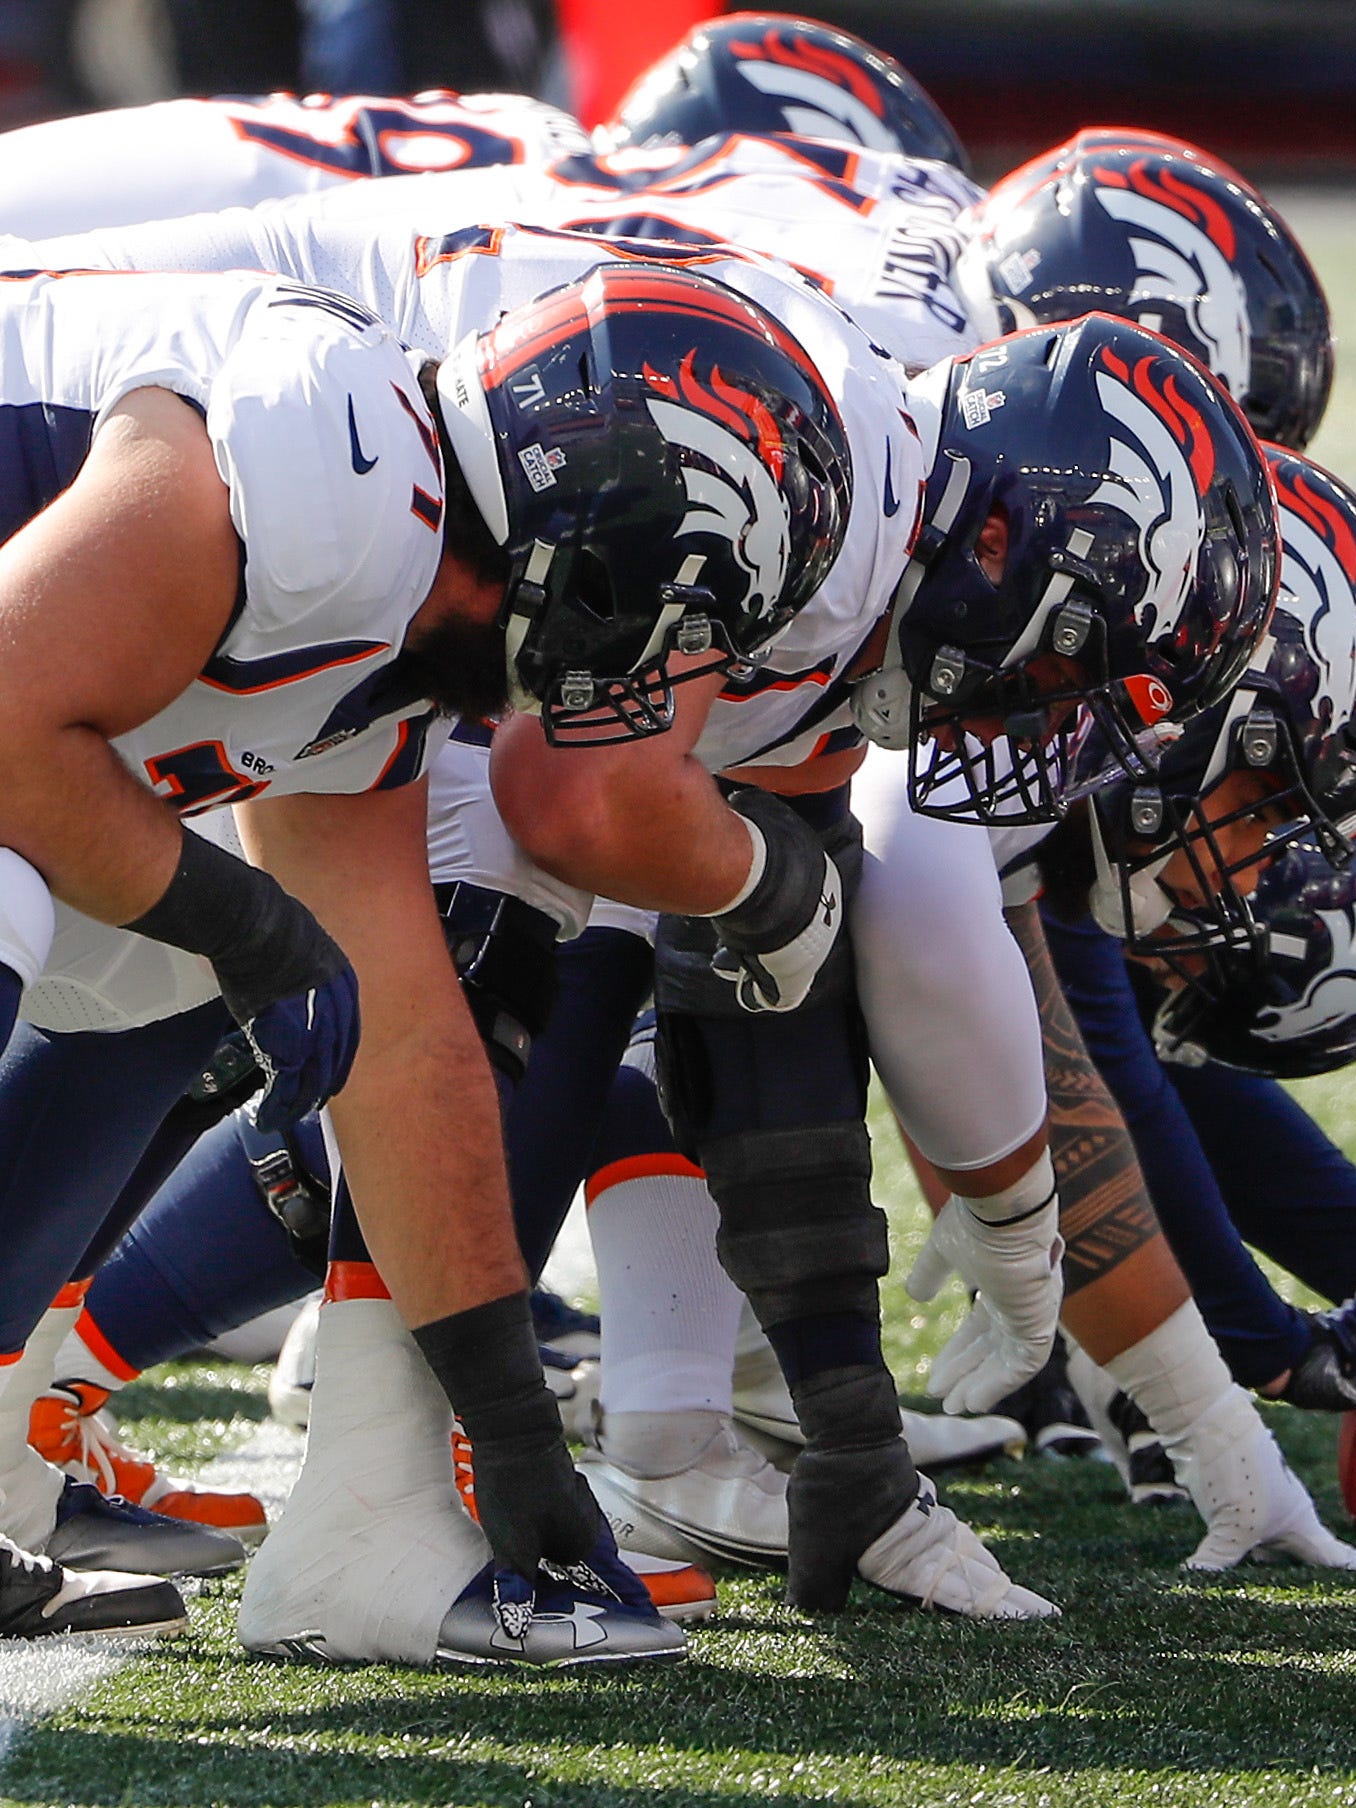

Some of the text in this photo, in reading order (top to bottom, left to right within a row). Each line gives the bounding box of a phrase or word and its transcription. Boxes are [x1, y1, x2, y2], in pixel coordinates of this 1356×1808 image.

[979, 344, 1008, 374] 72
[512, 373, 546, 409] 71
[966, 395, 980, 426] CATCH
[522, 450, 547, 488] CATCH
[534, 446, 553, 483] CRUCIAL
